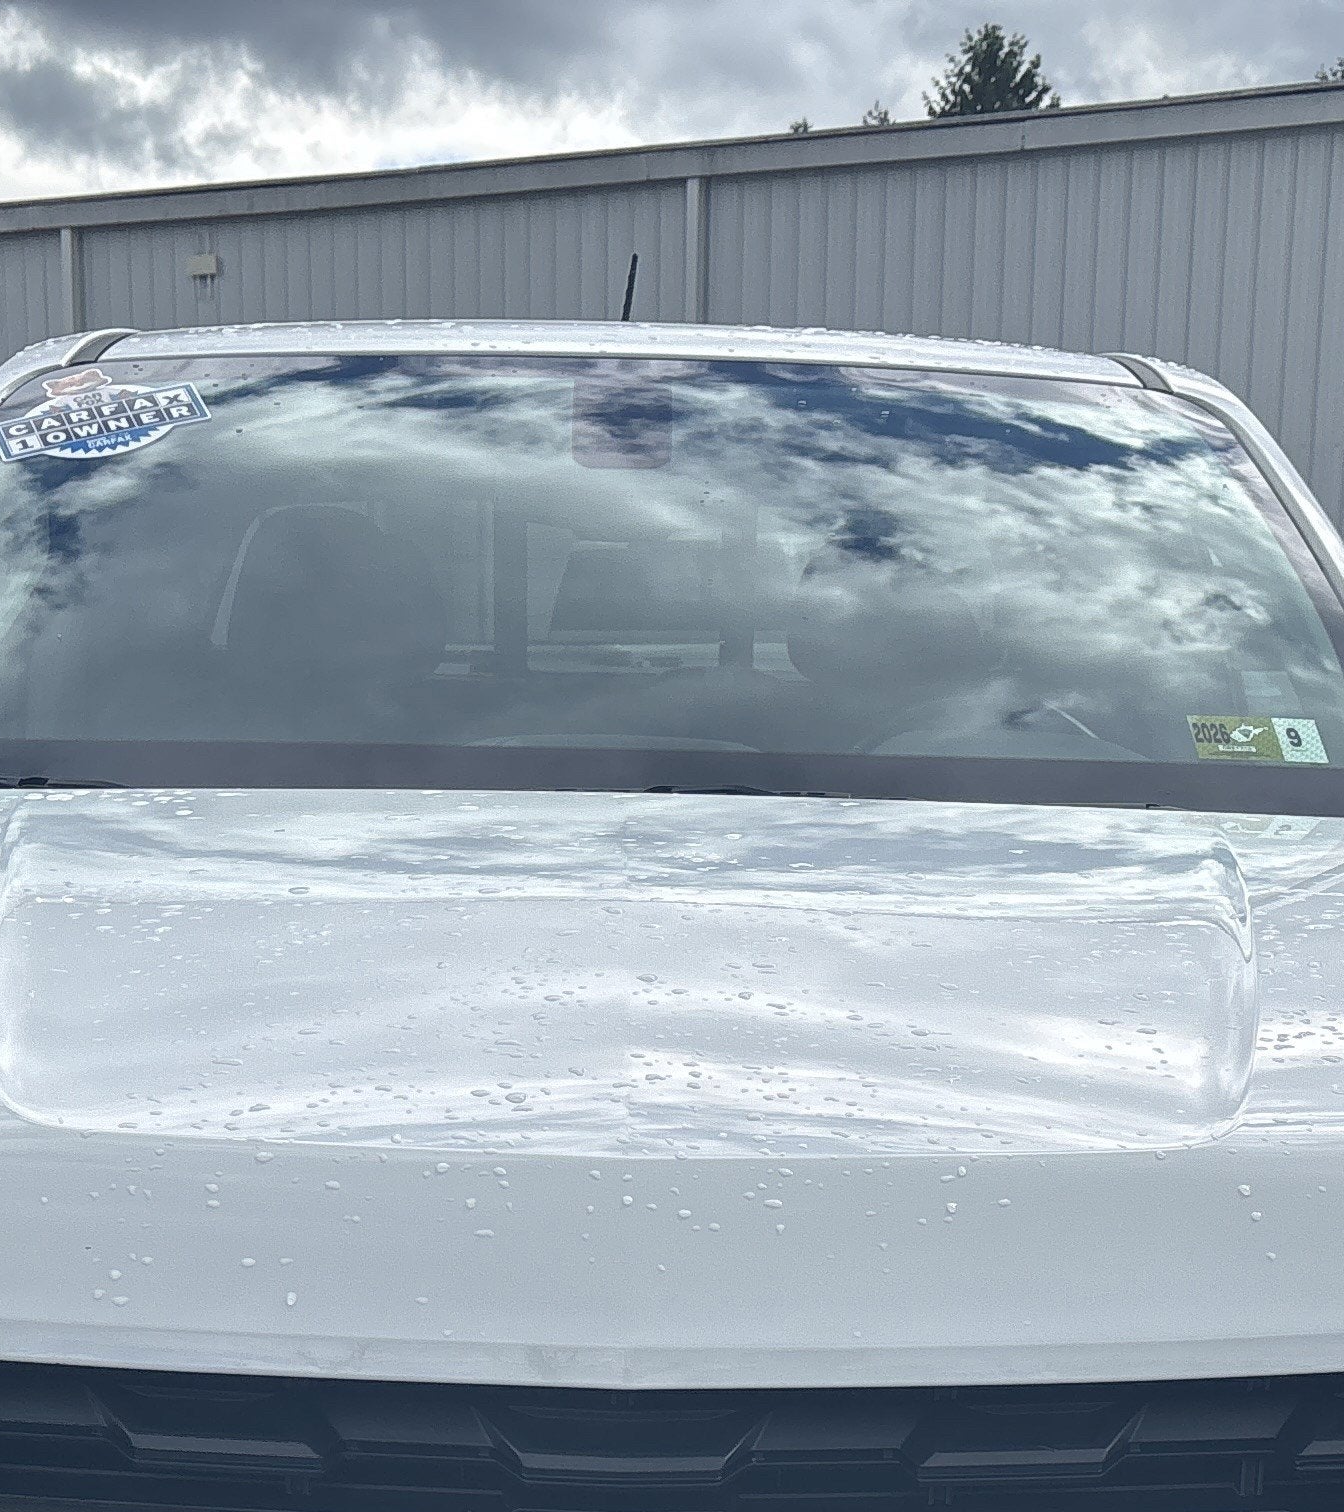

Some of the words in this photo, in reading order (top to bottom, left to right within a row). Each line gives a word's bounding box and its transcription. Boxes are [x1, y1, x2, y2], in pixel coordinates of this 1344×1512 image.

[8, 388, 186, 437] CARFAX
[1191, 722, 1232, 744] 2026
[1285, 727, 1303, 748] 9
